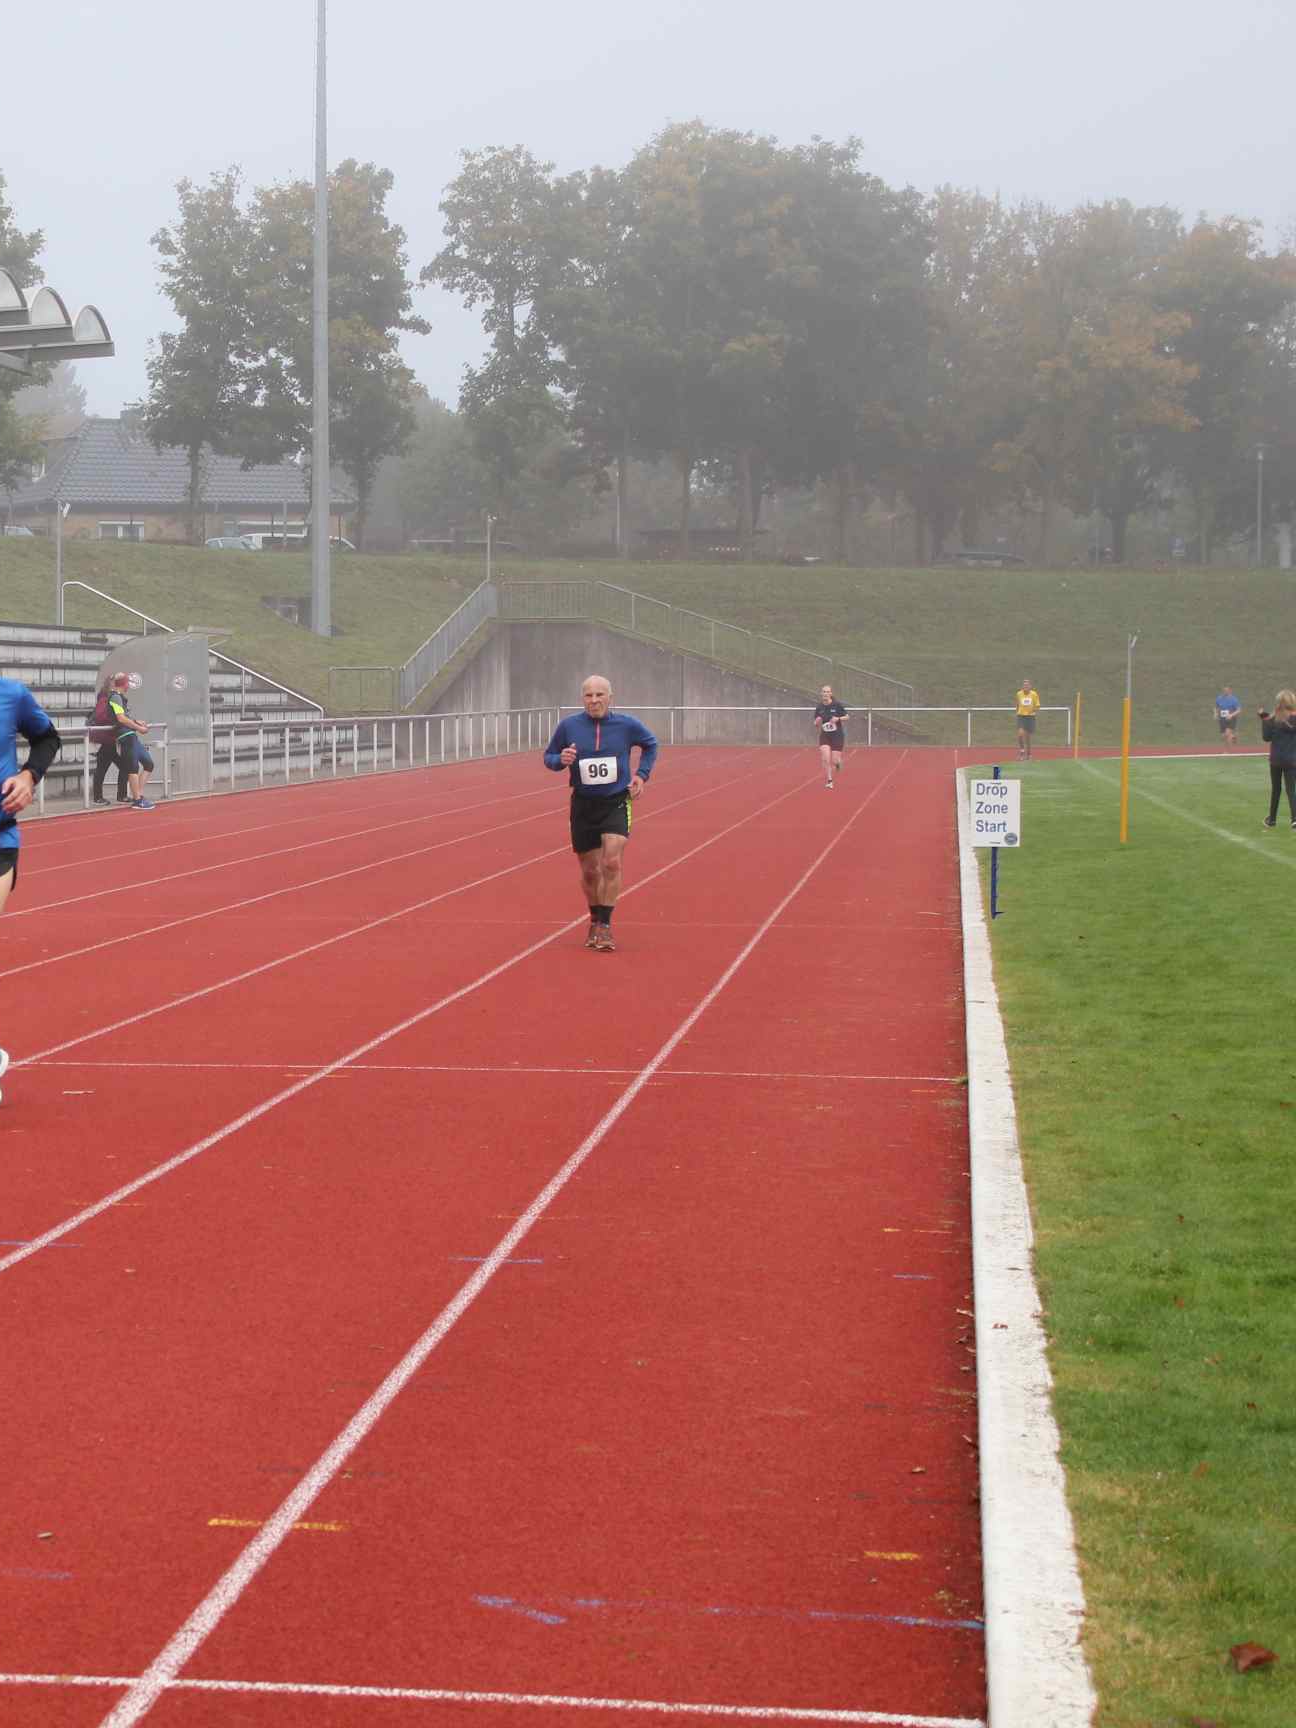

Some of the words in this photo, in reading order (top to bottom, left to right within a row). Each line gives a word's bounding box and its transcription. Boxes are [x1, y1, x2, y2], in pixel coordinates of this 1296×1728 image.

[588, 763, 608, 778] 96
[976, 783, 1008, 798] Drop
[976, 802, 1008, 815] Zone
[976, 820, 1008, 833] Start
